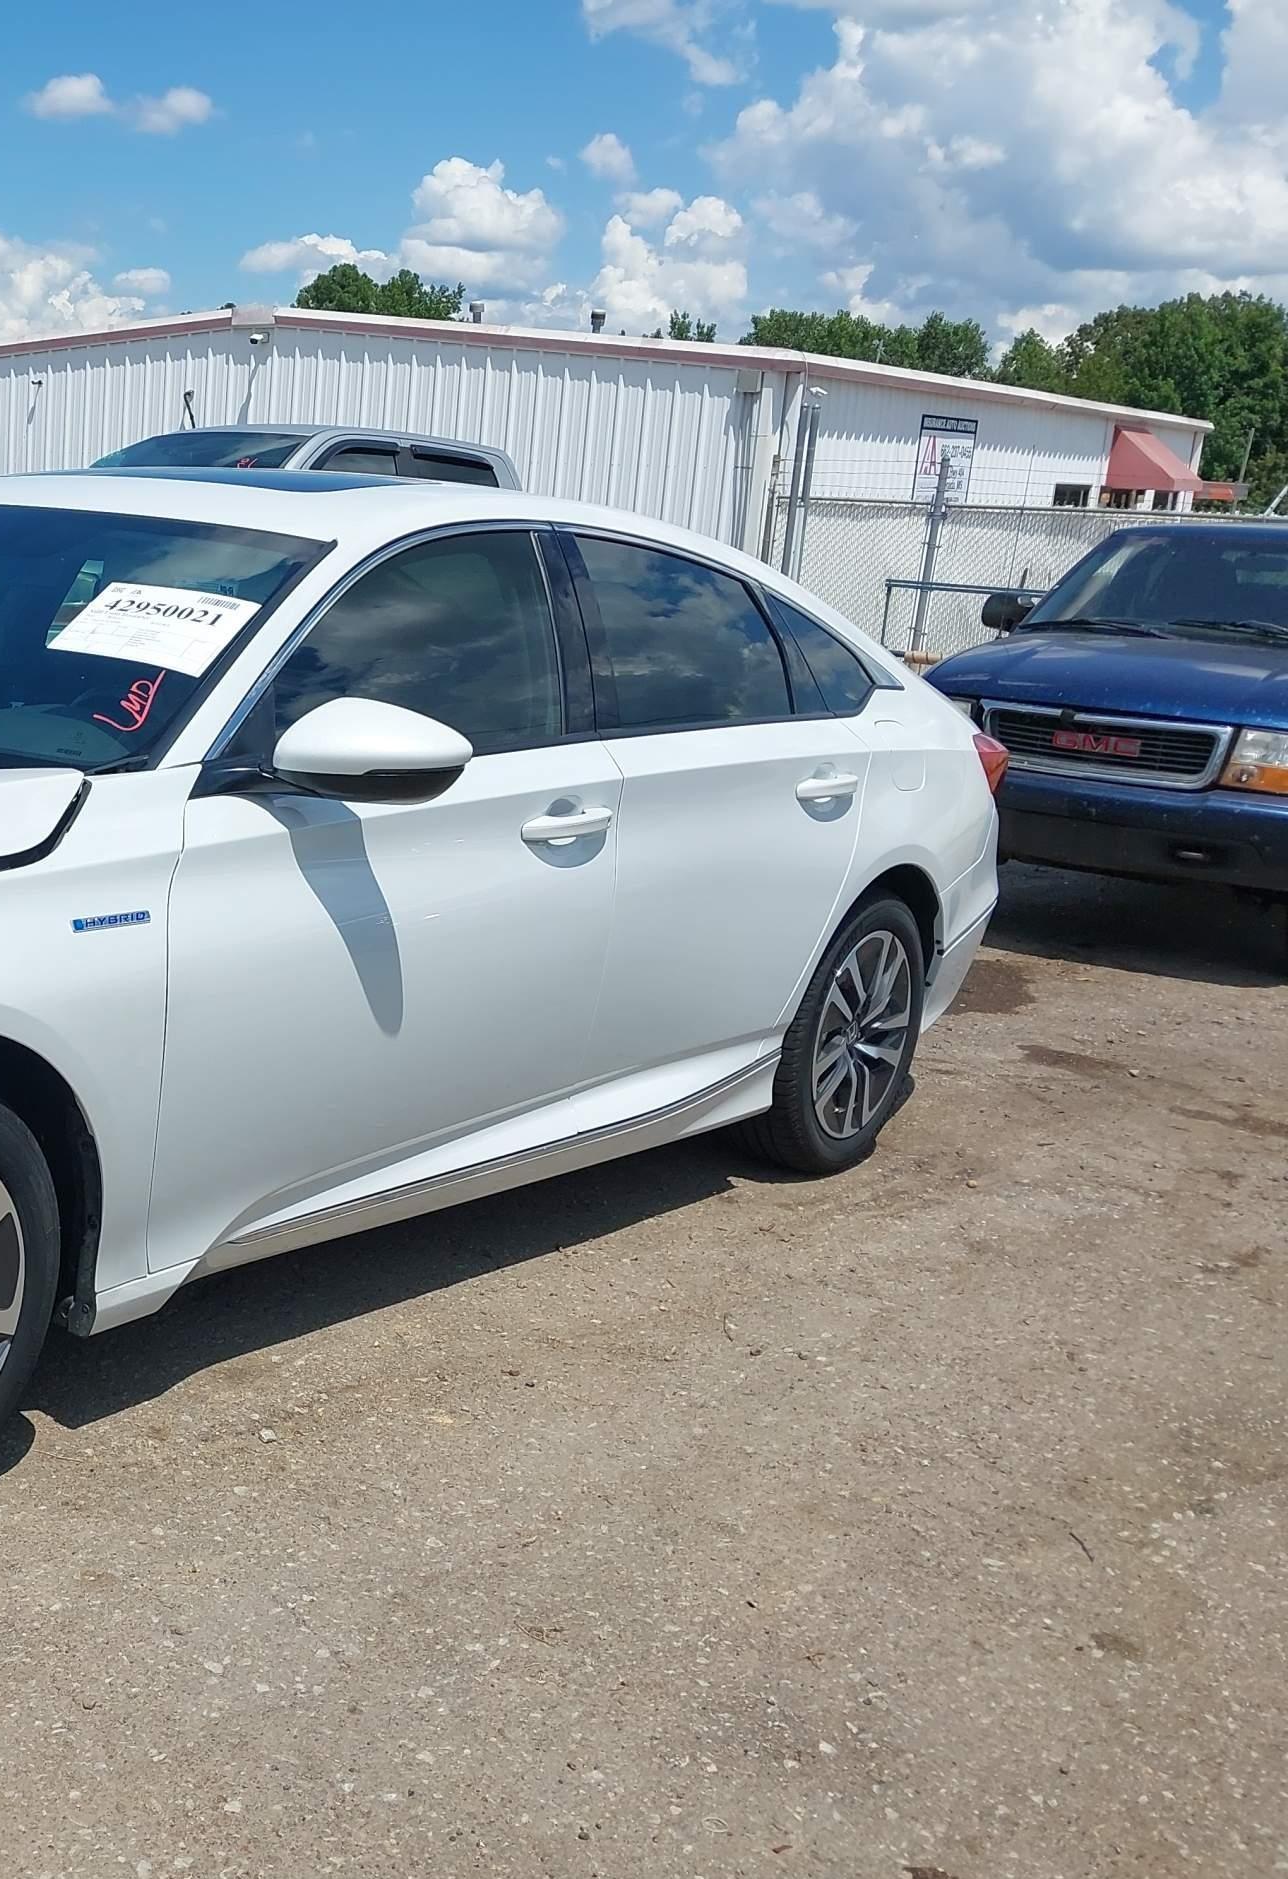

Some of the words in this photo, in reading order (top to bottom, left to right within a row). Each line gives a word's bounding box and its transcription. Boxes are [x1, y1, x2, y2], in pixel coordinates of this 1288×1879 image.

[104, 598, 224, 626] 42950021
[1052, 731, 1142, 757] GMC
[85, 911, 147, 928] HYBRID
